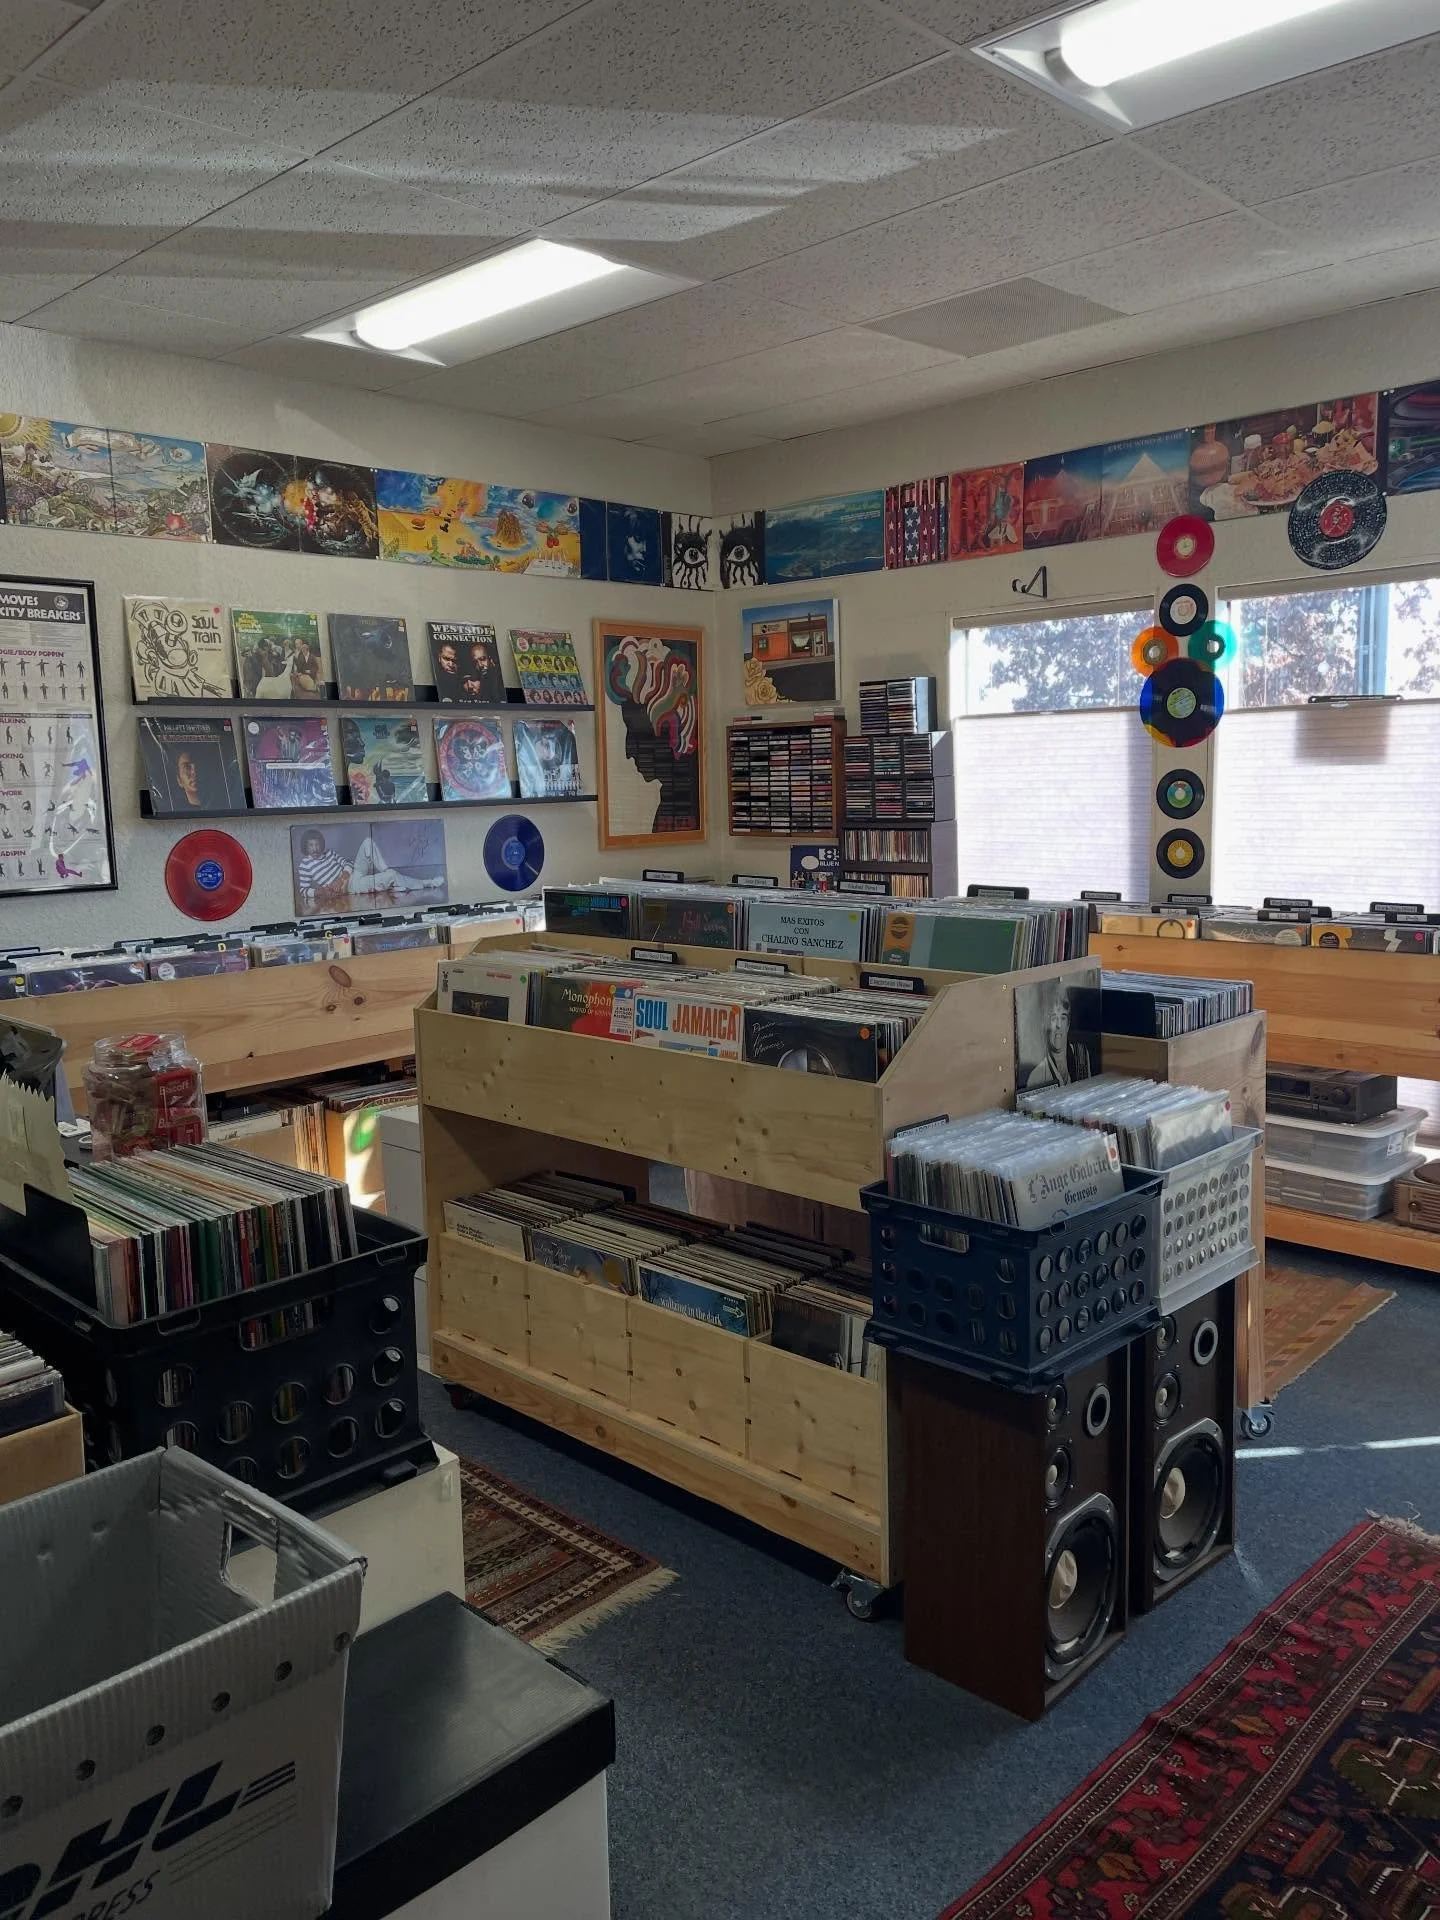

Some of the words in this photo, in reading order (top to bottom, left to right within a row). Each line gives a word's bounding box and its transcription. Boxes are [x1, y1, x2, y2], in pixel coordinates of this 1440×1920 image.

[0, 594, 38, 606] MOVES
[0, 606, 24, 617] CITY
[26, 608, 81, 621] BREAKERS
[191, 614, 218, 629] SOUL
[431, 623, 491, 635] WESTSIDE
[433, 633, 493, 643] CONNECTION
[780, 916, 797, 925] MAS
[797, 917, 825, 927] EXITOS
[325, 930, 332, 939] G
[793, 927, 810, 936] CON
[218, 943, 226, 952] D
[761, 934, 799, 946] CHALINO
[801, 938, 844, 949] SANCHEZ
[561, 988, 612, 1008] Monophon
[635, 998, 669, 1031] SOUL
[671, 1003, 738, 1042] JAMAICA
[159, 1080, 190, 1096] Biscoff
[243, 1106, 249, 1114] H
[1064, 1182, 1098, 1206] Genesis
[706, 1309, 723, 1327] dark
